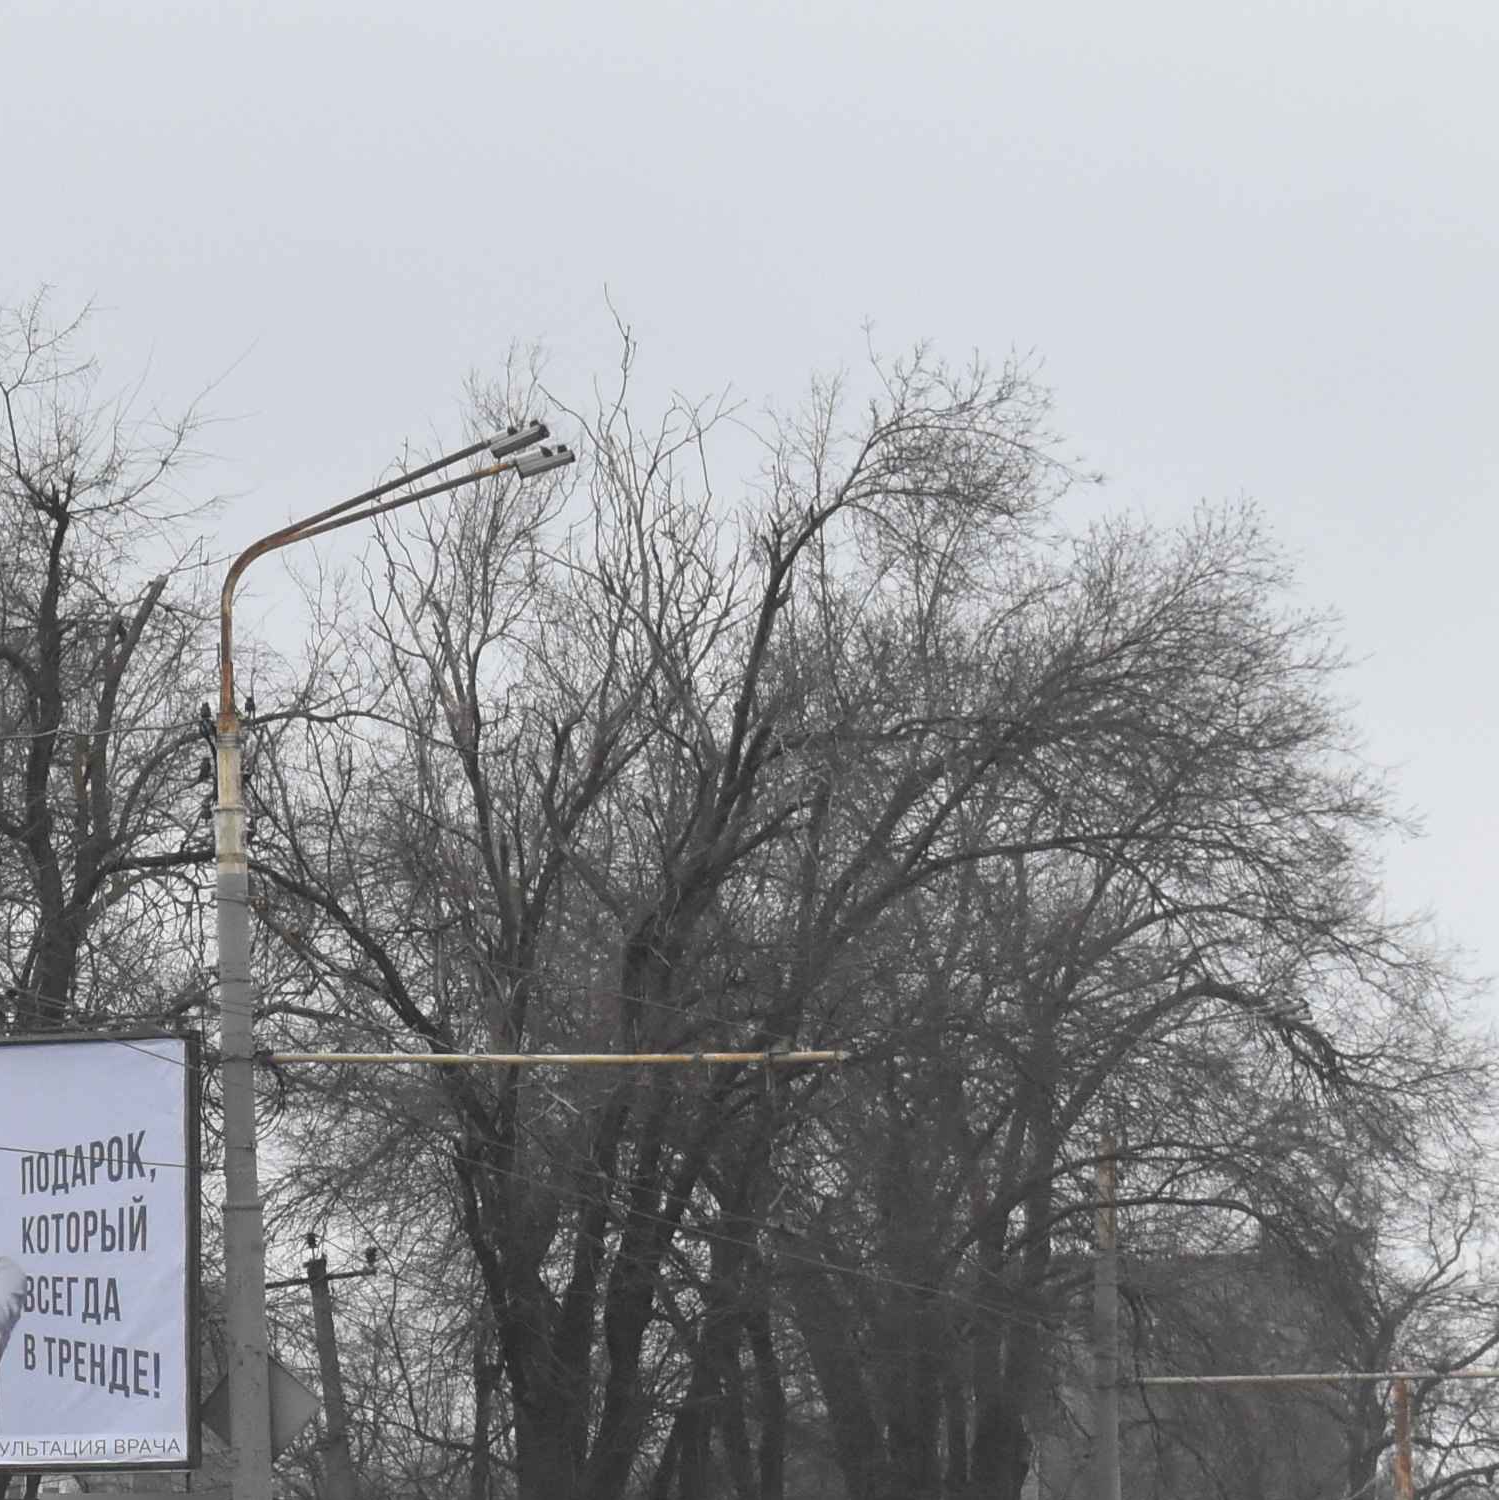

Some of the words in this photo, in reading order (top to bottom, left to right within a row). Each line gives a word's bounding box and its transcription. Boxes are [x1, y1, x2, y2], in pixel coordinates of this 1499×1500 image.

[21, 1130, 156, 1196] ПОДАРОК,
[21, 1195, 147, 1254] КОТОРЫЙ
[23, 1275, 122, 1325] ВСЕГДА
[23, 1333, 37, 1371] В
[43, 1336, 161, 1399] ТРЕНДЕ!
[114, 1437, 182, 1456] ВРАЧА
